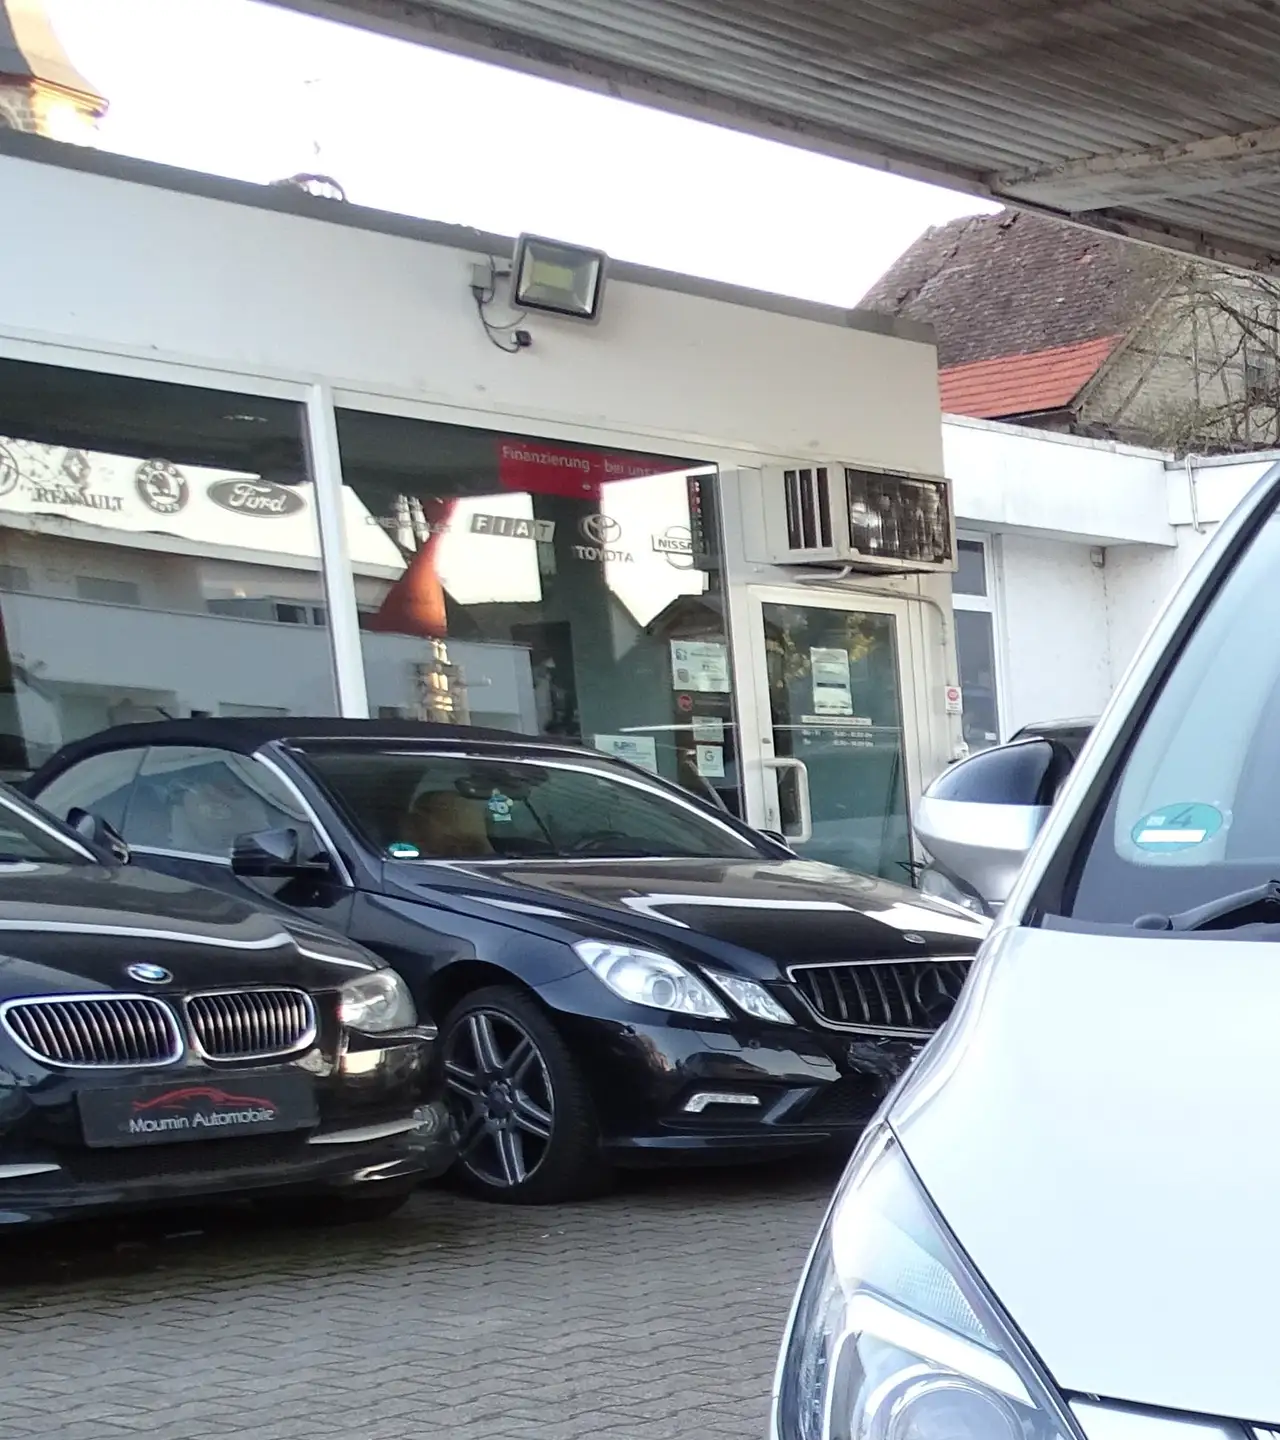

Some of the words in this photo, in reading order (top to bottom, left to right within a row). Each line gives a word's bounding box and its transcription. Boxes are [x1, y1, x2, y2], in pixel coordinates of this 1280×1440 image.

[502, 444, 589, 472] Finanzierung
[604, 458, 624, 473] bei
[32, 487, 125, 512] RENAULT
[228, 483, 287, 513] Ford
[475, 515, 553, 540] FIAT
[574, 545, 635, 564] TOYOTA
[1168, 804, 1197, 828] 4
[129, 1115, 189, 1133] Moumin
[192, 1107, 274, 1128] Automobile
